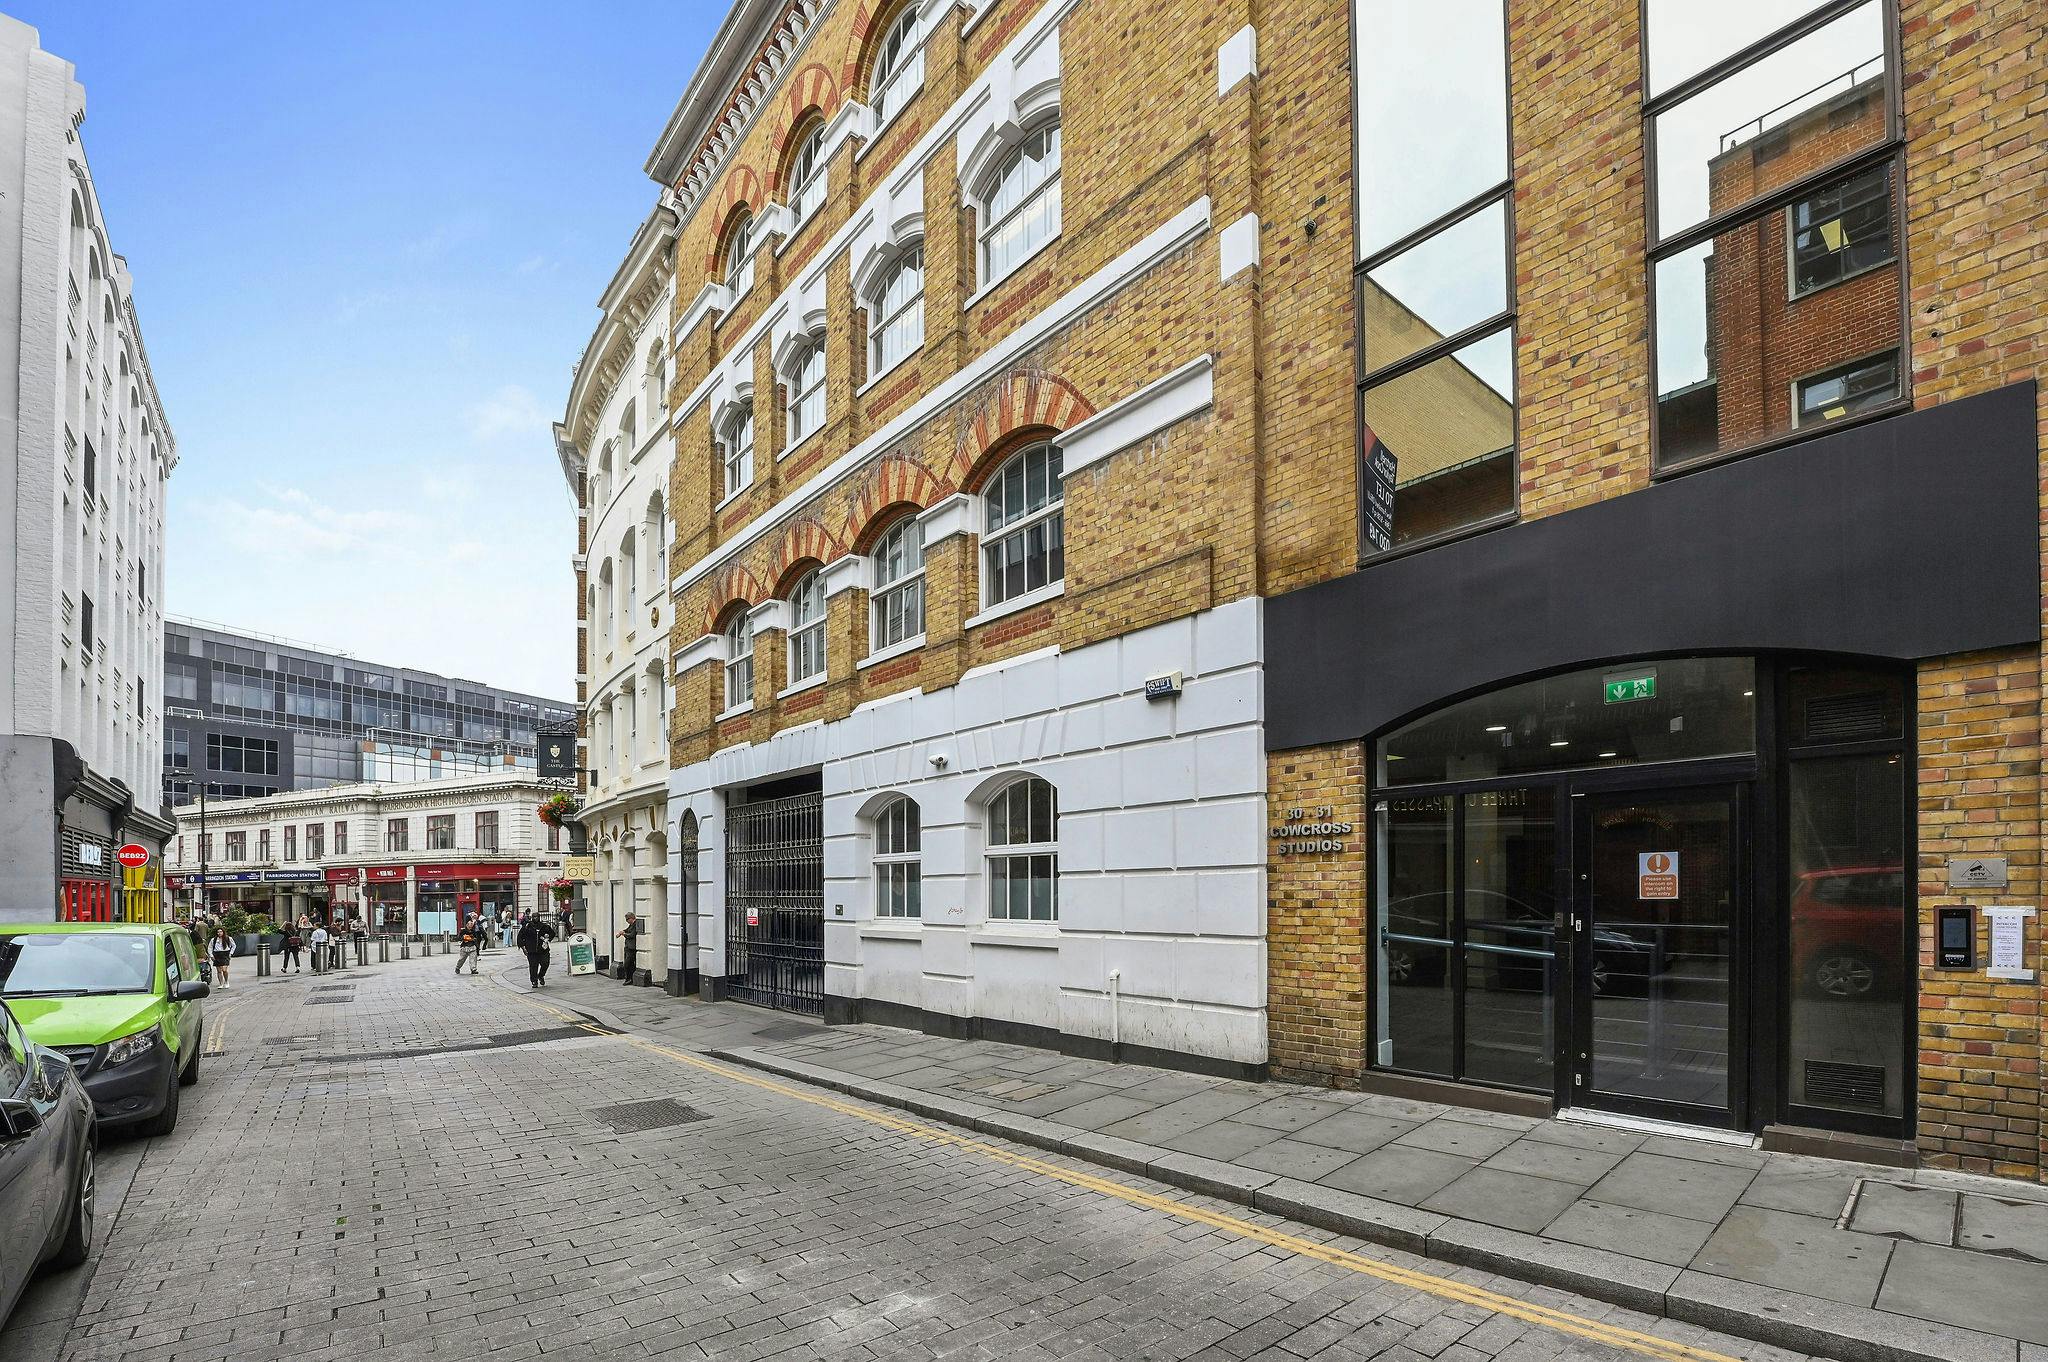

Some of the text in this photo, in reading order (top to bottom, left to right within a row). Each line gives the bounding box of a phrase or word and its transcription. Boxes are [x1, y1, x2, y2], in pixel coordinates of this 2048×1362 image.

[430, 797, 448, 807] HIGH
[449, 795, 481, 806] HOLBORN
[484, 792, 513, 803] STATION
[329, 803, 360, 815] RAILWAY
[1287, 804, 1332, 819] 30 31
[1270, 821, 1352, 838] COWCROSS
[1279, 839, 1343, 855] STUDIOS
